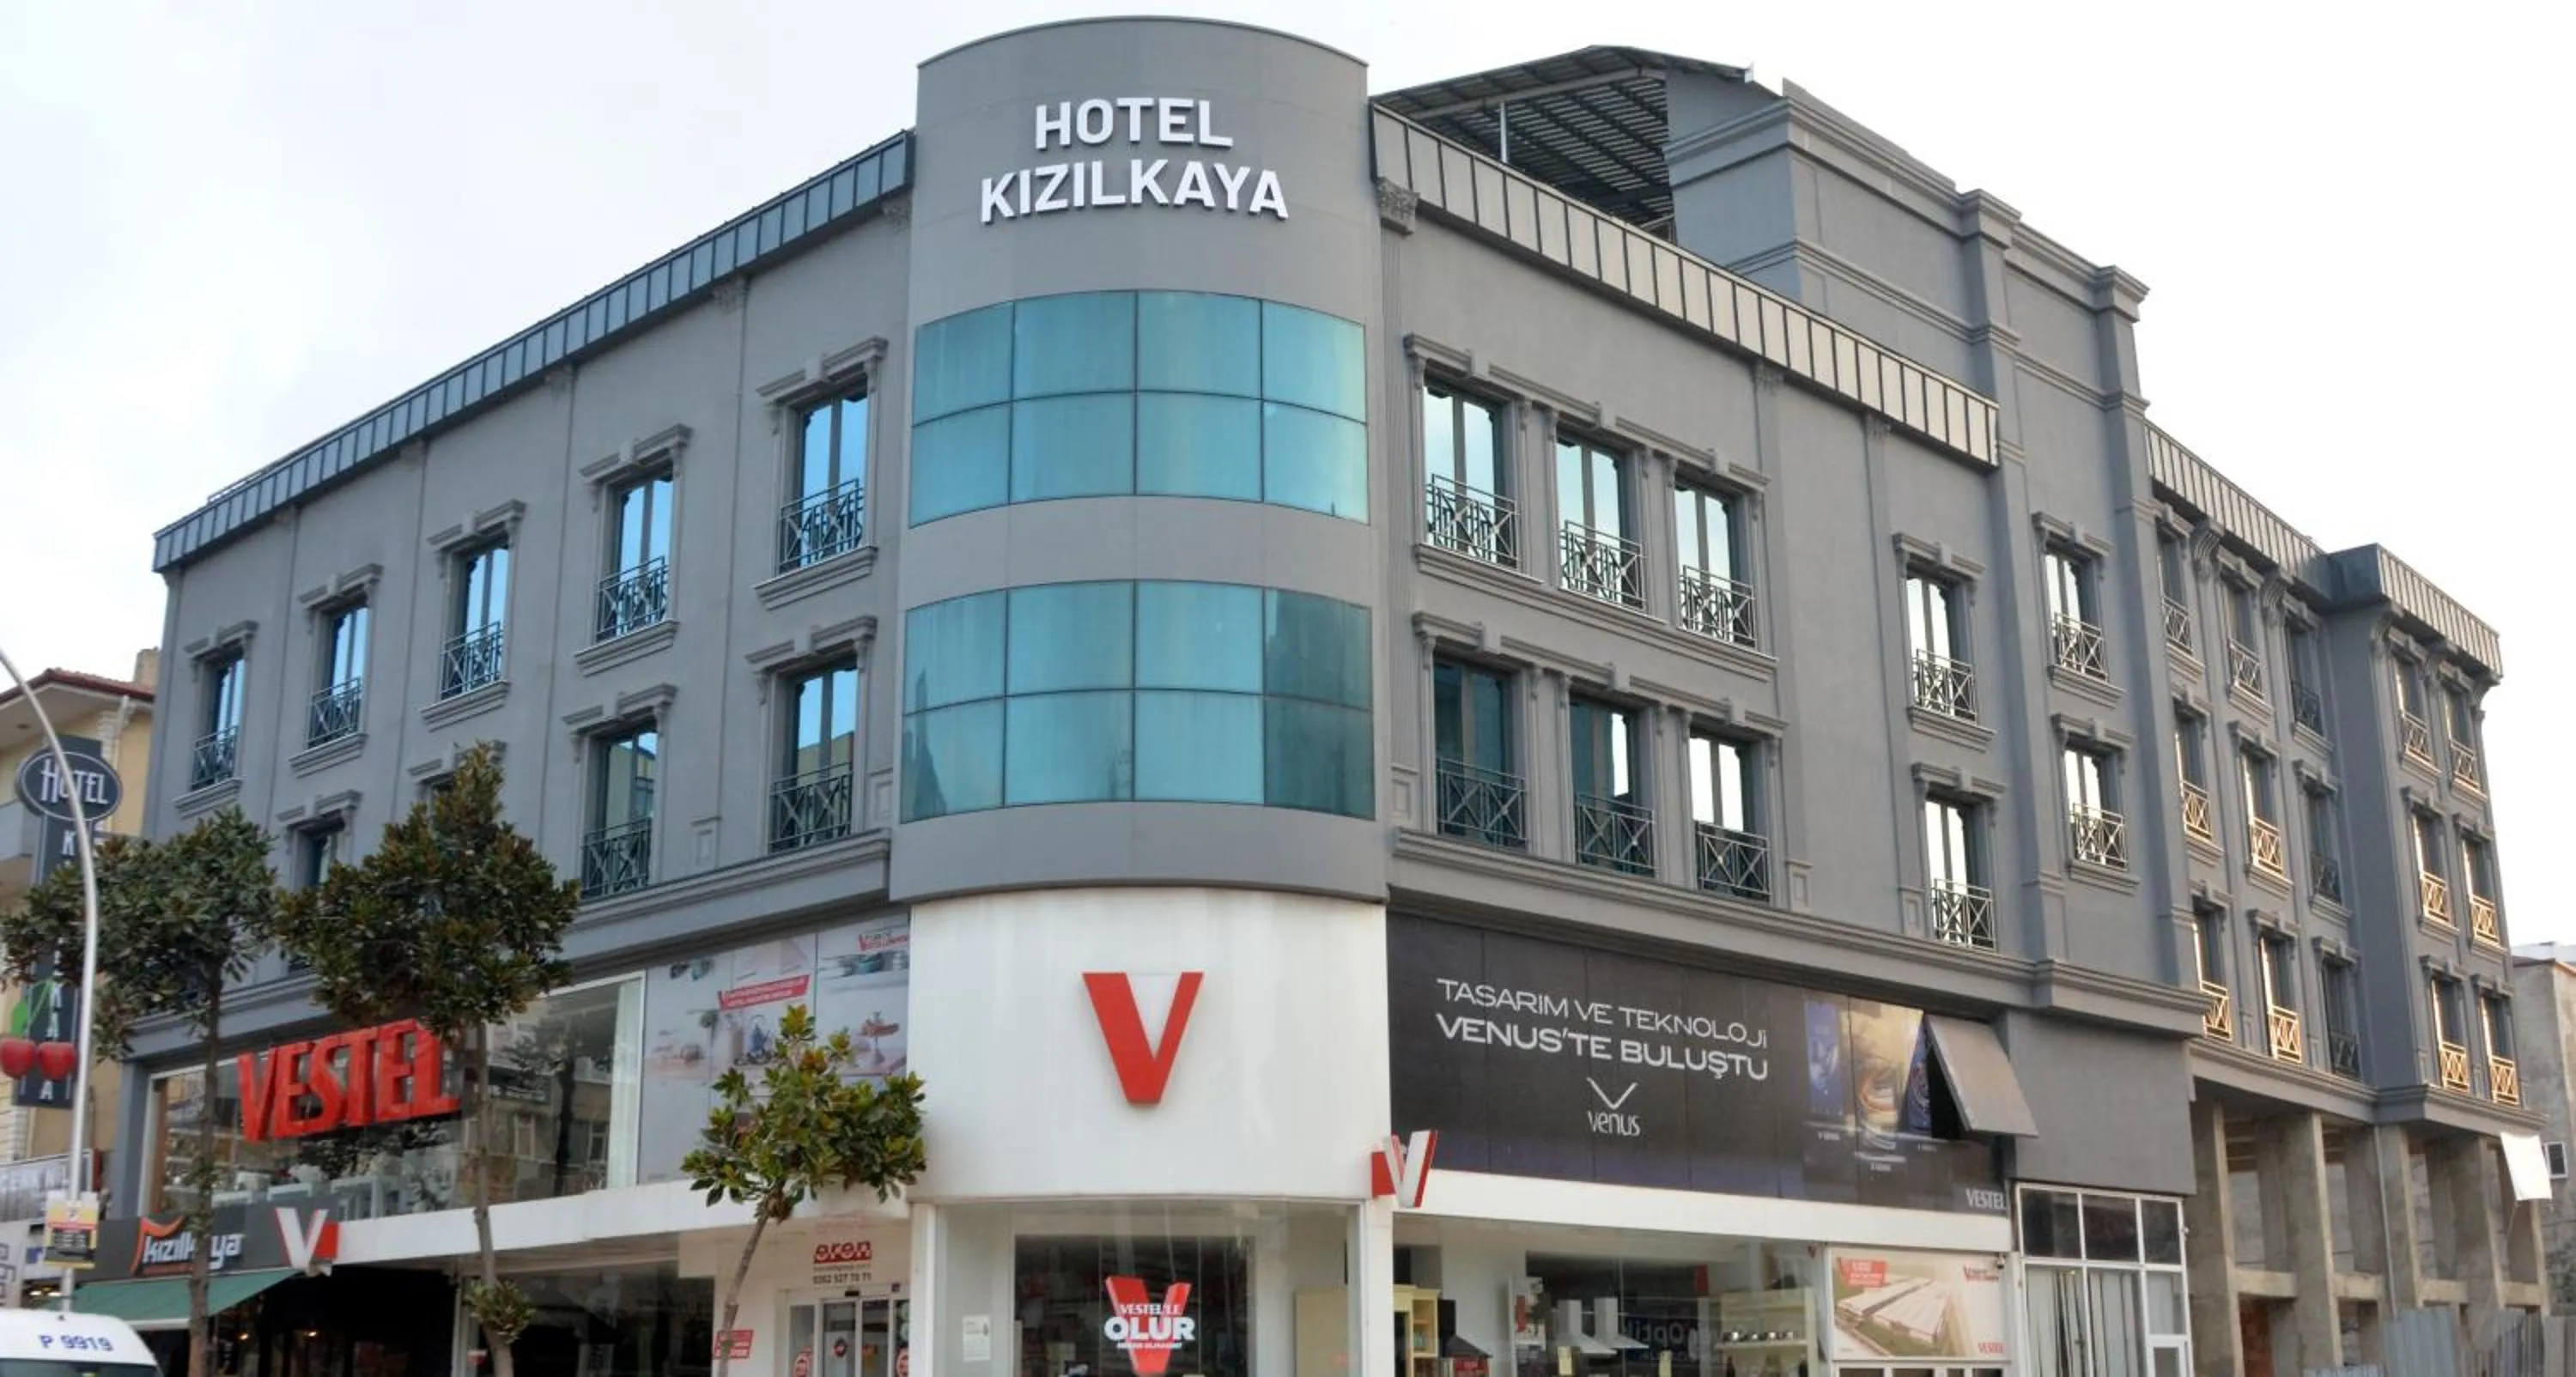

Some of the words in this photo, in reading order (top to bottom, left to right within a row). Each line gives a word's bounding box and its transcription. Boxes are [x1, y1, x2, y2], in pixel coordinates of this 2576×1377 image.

[1035, 98, 1234, 149] HOTEL
[981, 159, 1289, 223] KIZILKAYA
[1437, 978, 1569, 1018] TASARIM
[1574, 999, 1613, 1025] VE
[1082, 972, 1204, 1104] V
[1436, 1013, 1613, 1060] VENUS'TE
[1620, 1040, 1769, 1080] BULUŞTU
[237, 1017, 460, 1144] VESTEL
[1965, 1188, 2007, 1210] VESTEL
[39, 1335, 54, 1349] P
[60, 1335, 113, 1351] 9919
[1104, 1316, 1196, 1341] OLUR
